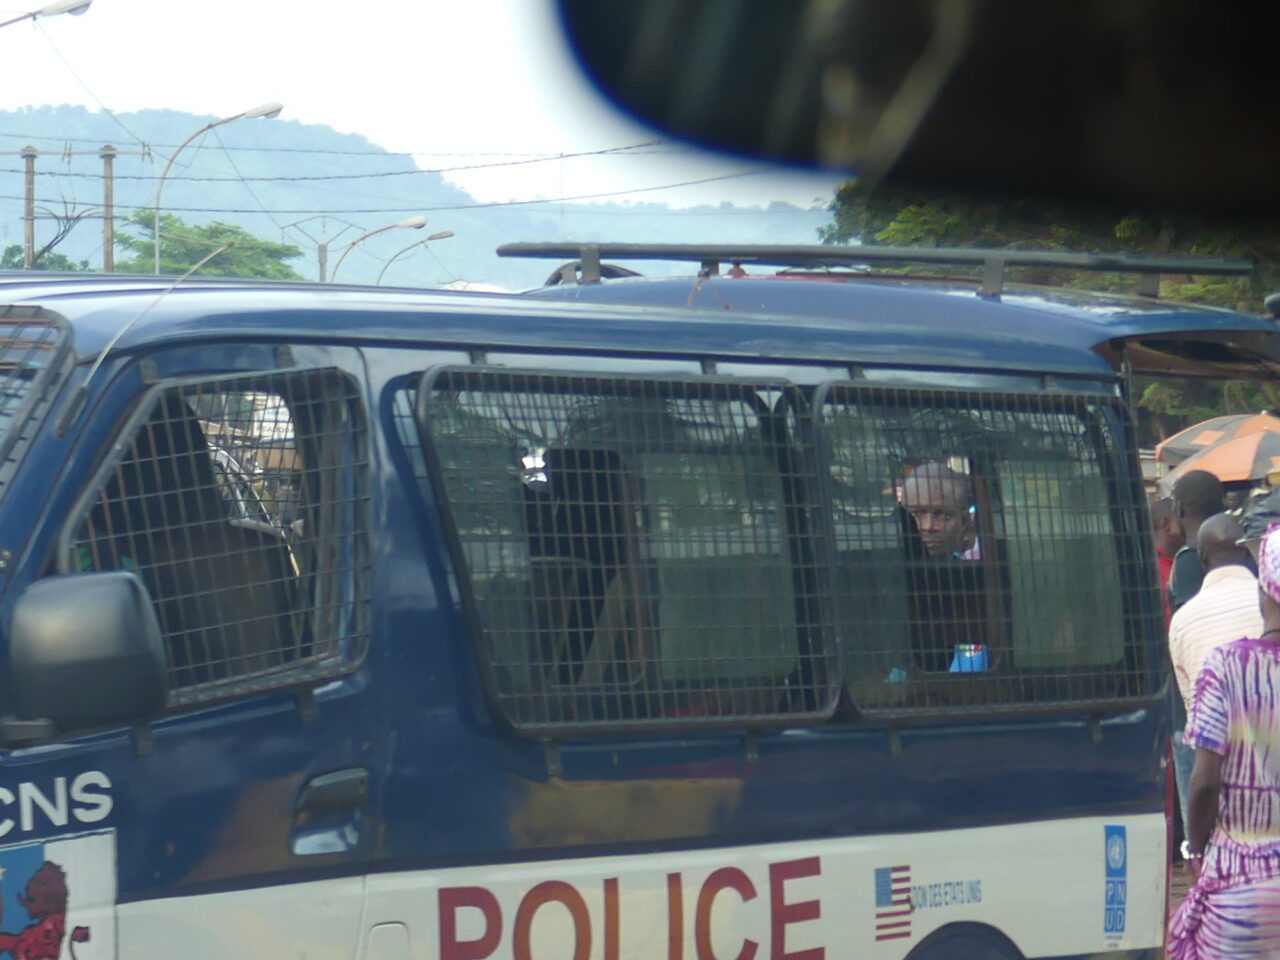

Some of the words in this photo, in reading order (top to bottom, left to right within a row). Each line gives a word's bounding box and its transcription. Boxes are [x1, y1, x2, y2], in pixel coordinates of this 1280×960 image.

[912, 885, 928, 908] DON
[929, 883, 942, 907] DES
[944, 881, 964, 906] ETATS
[966, 880, 982, 904] UNIS
